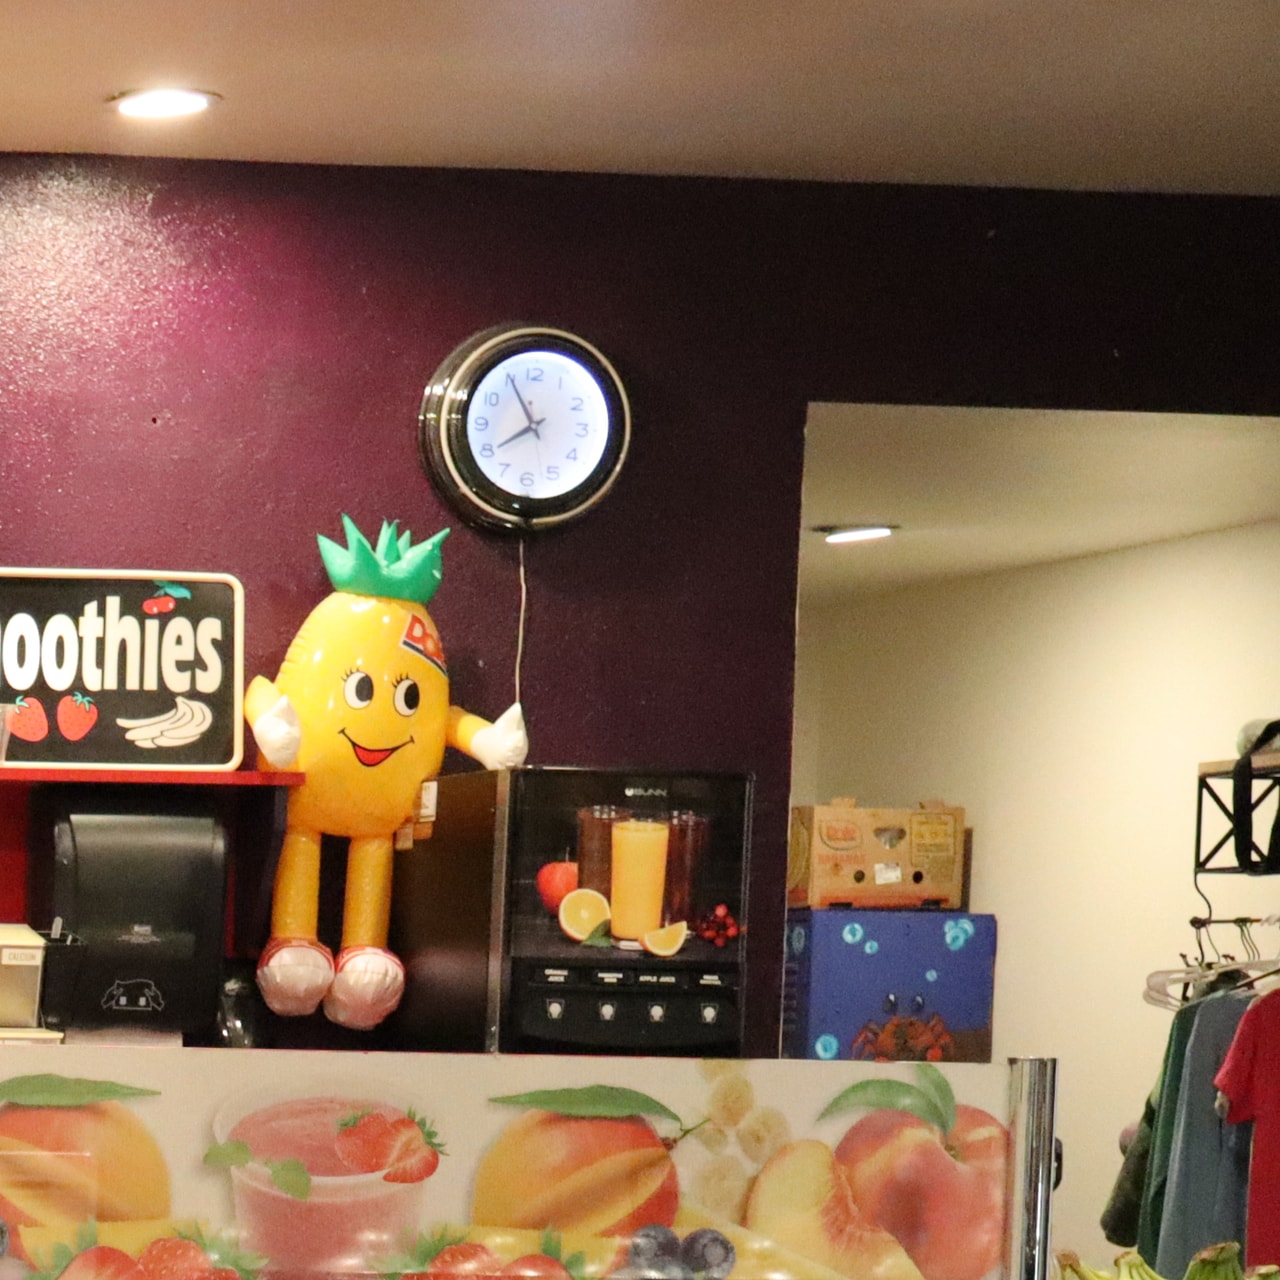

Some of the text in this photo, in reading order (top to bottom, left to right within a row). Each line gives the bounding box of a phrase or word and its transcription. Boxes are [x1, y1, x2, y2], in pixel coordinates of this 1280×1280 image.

[526, 368, 543, 382] 12
[559, 376, 562, 389] 1
[485, 392, 499, 406] 10
[571, 398, 583, 411] 2
[475, 417, 488, 431] 9
[576, 423, 589, 437] 3
[480, 444, 494, 458] 8
[566, 449, 578, 461] 4
[499, 463, 511, 477] 7
[547, 466, 560, 480] 5
[520, 472, 534, 487] 6
